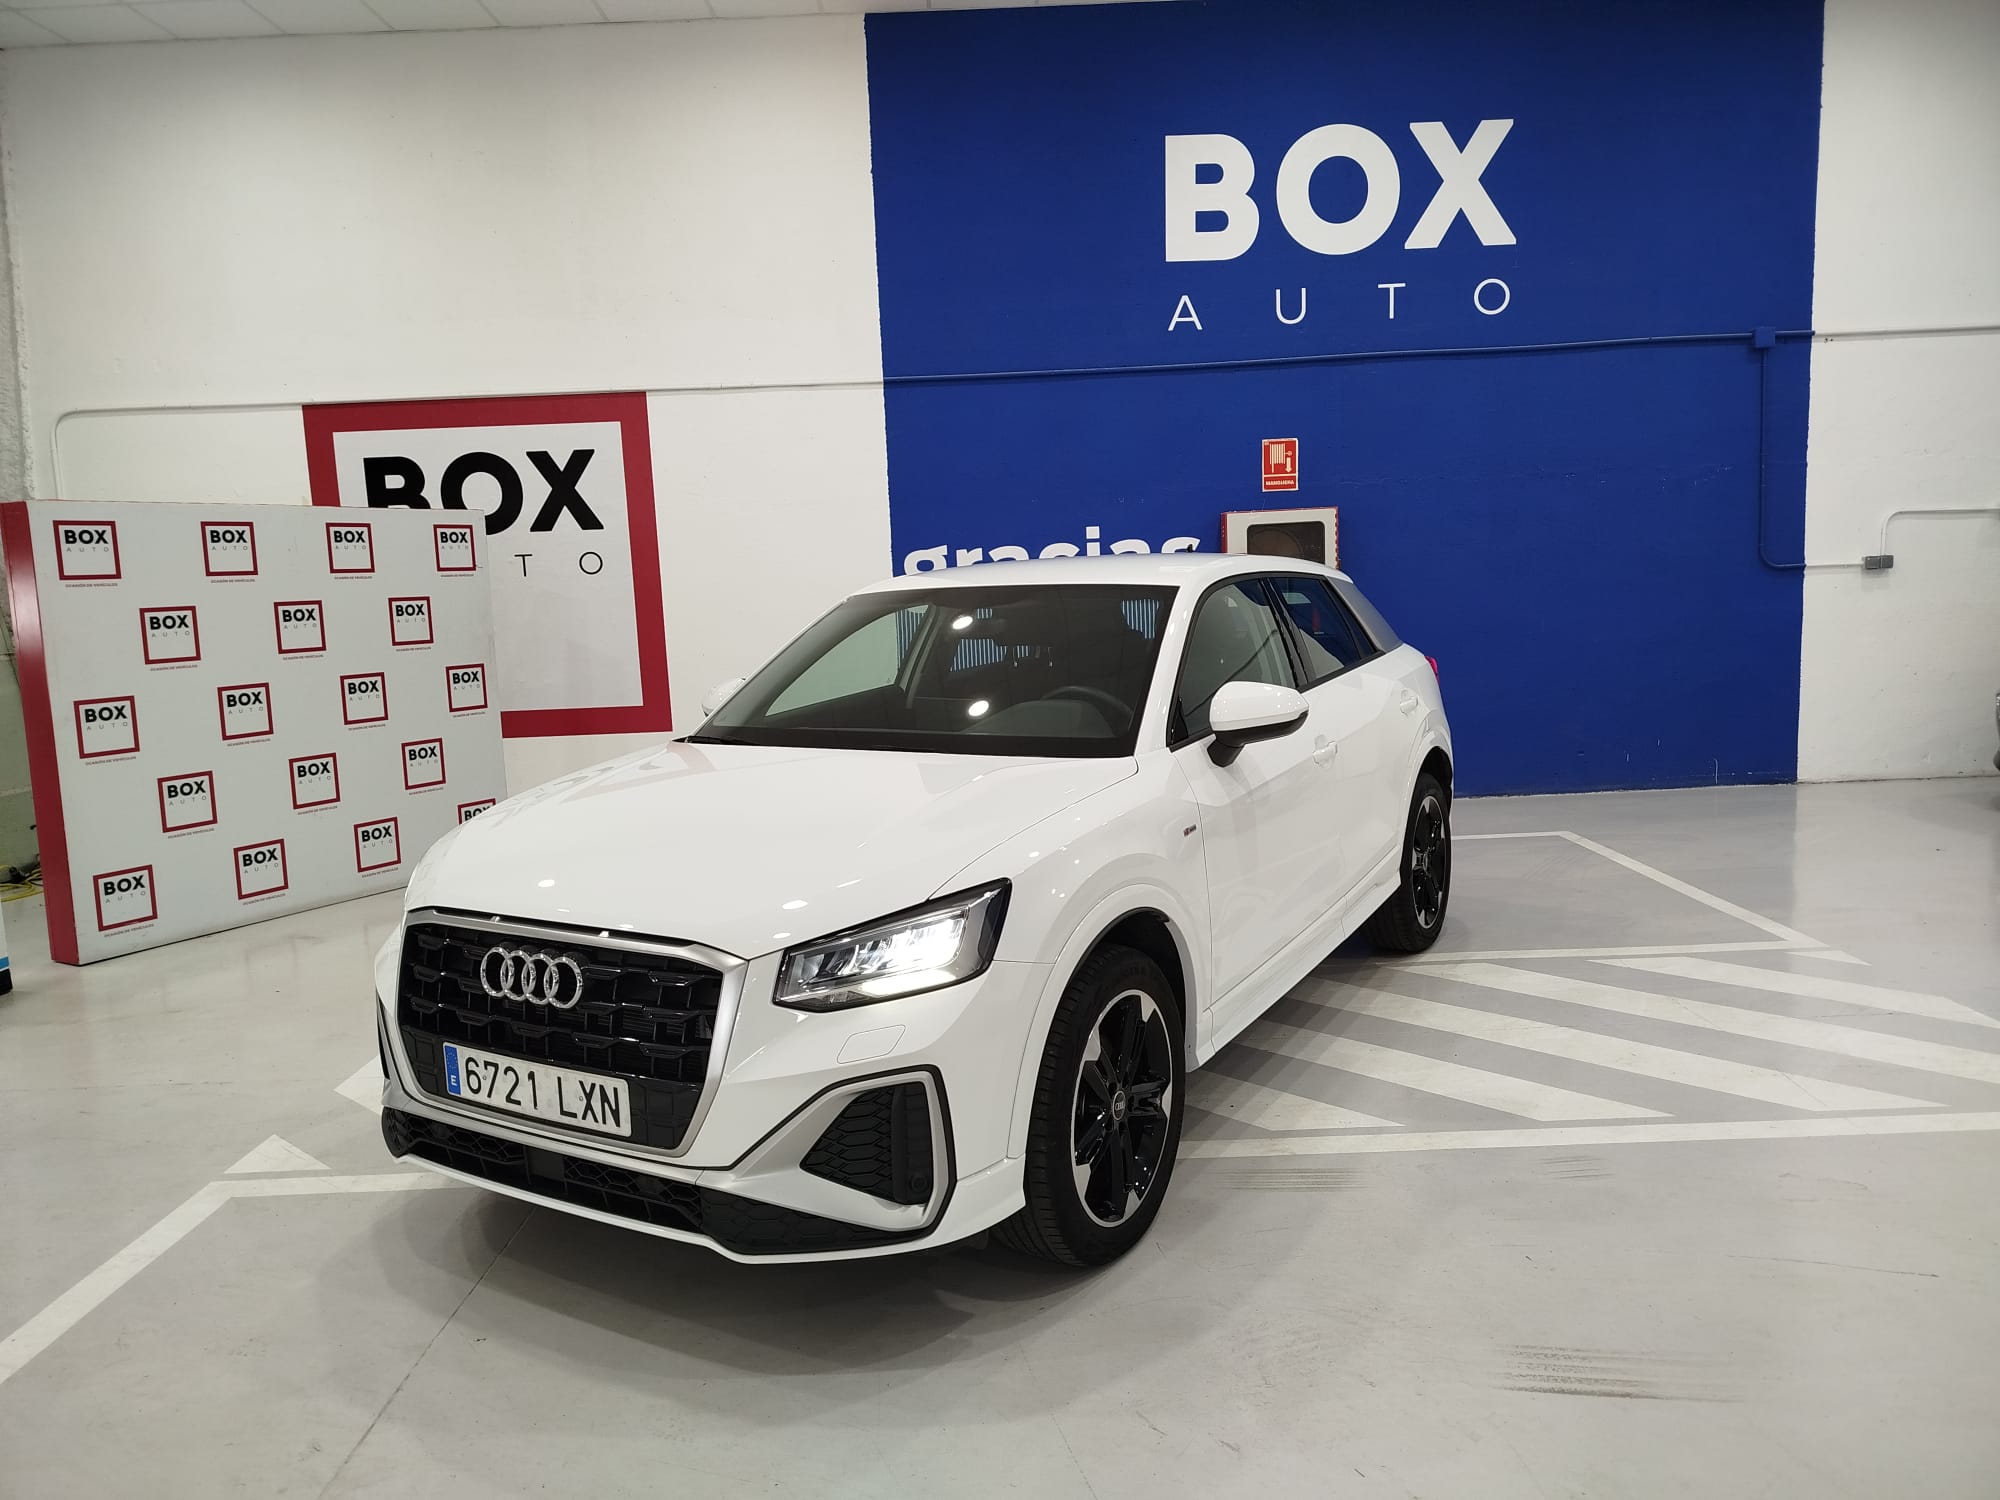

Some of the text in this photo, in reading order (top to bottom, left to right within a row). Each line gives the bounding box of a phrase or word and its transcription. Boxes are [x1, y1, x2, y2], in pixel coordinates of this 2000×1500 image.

[1165, 119, 1517, 262] BOX
[1168, 278, 1511, 331] AUTO
[363, 448, 604, 536] BOX
[64, 530, 108, 544] BOX
[210, 530, 247, 543] BOX
[334, 531, 365, 543] BOX
[440, 532, 468, 543] BOX
[282, 608, 316, 622] BOX
[396, 604, 425, 616] BOX
[150, 615, 189, 630] BOX
[453, 671, 479, 684] BOX
[348, 680, 379, 694] BOX
[226, 691, 263, 707] BOX
[85, 705, 127, 723] BOX
[408, 746, 437, 761] BOX
[297, 761, 330, 778] BOX
[167, 780, 206, 798] BOX
[361, 825, 392, 842] BOX
[242, 848, 278, 867] BOX
[104, 875, 145, 896] BOX
[451, 1057, 621, 1128] E 6721 LXN
